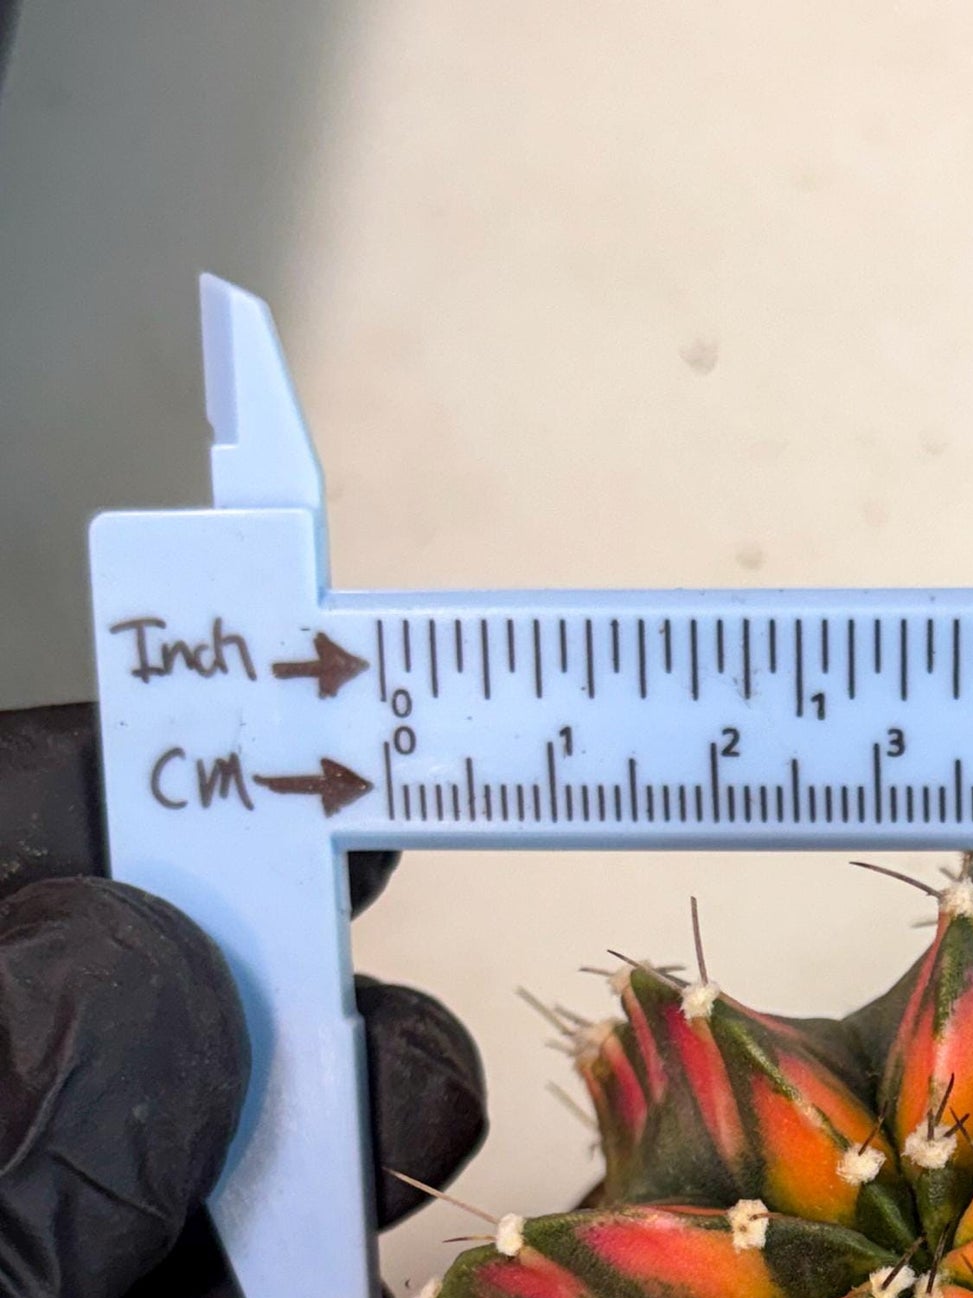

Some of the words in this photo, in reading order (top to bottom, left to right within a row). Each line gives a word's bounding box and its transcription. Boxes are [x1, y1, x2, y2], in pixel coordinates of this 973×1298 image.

[110, 616, 257, 683] Inch
[391, 689, 412, 718] 0
[810, 692, 826, 720] 1
[394, 725, 416, 755] 0
[558, 726, 574, 756] 1
[721, 728, 740, 757] 2
[887, 729, 906, 757] 3
